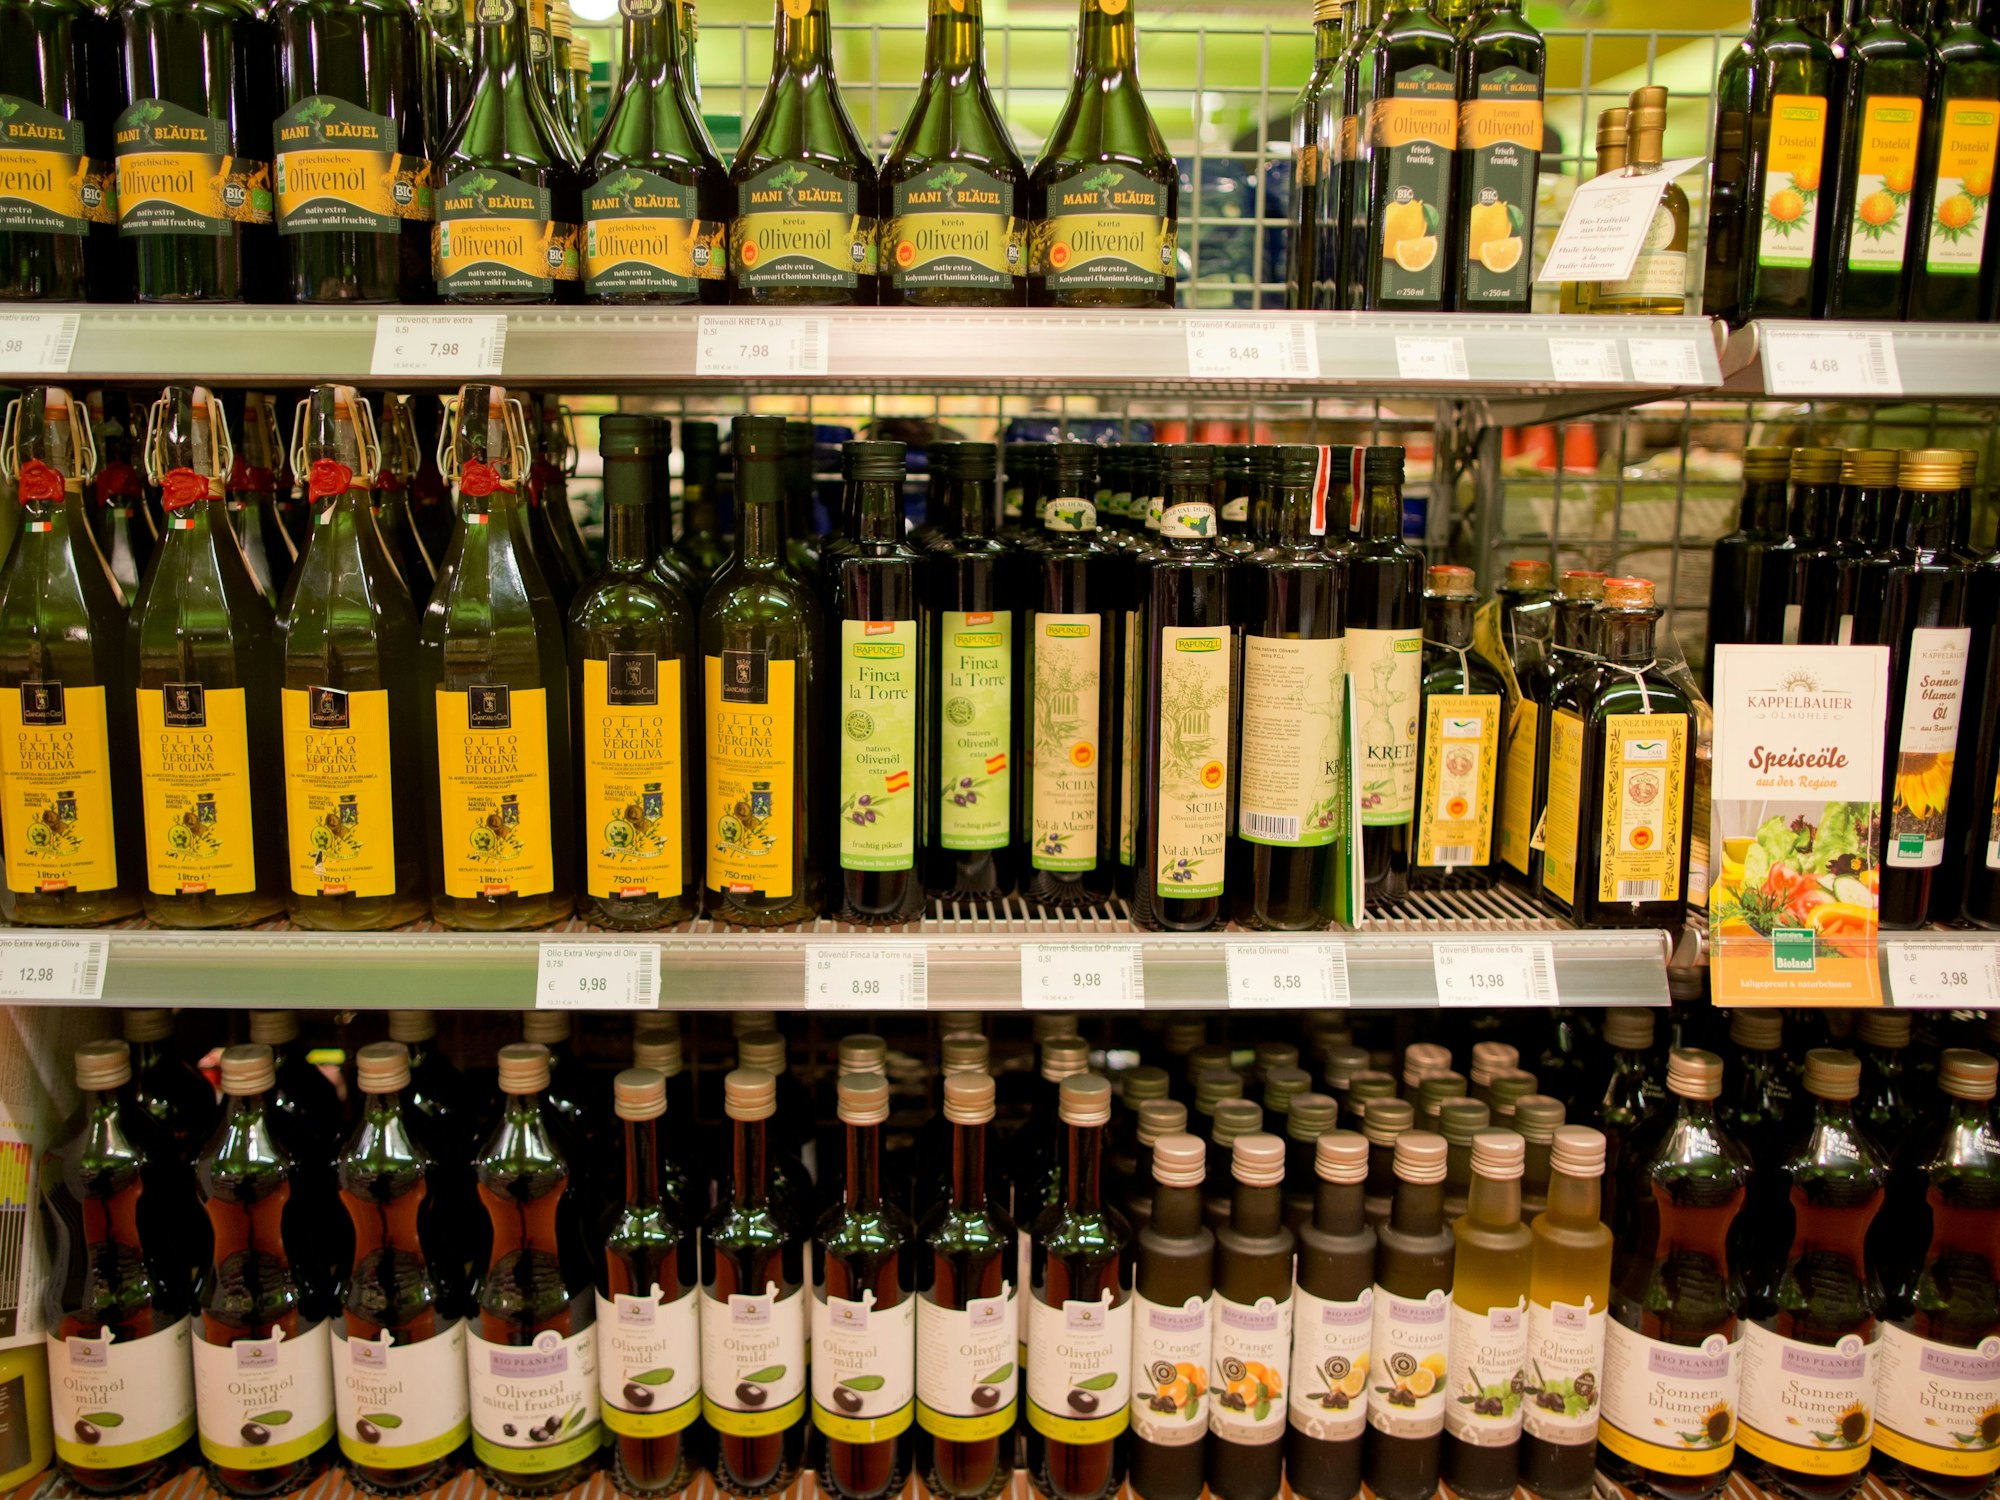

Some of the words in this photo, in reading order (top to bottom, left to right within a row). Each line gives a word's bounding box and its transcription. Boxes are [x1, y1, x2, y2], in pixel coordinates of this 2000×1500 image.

[117, 130, 140, 143] MANI
[155, 126, 207, 141] BLÄUEL
[282, 125, 309, 141] MANI
[326, 121, 378, 139] BLÄUEL
[1778, 136, 1816, 147] Distelöl
[1871, 138, 1910, 150] Distelöl
[1951, 141, 1989, 153] Distelöl
[1411, 146, 1431, 155] frisch
[1496, 146, 1515, 155] frisch
[124, 170, 194, 194] Olivenöl
[290, 168, 365, 191] Olivenöl
[154, 219, 172, 227] mild
[174, 219, 205, 229] fruchtig
[453, 235, 523, 256] Olivenöl
[599, 235, 668, 256] Olivenöl
[759, 229, 831, 250] Olivenöl
[916, 230, 989, 251] Olivenöl
[1072, 230, 1144, 252] Olivenöl
[630, 279, 645, 287] mild
[647, 279, 677, 287] fruchtig
[704, 318, 735, 326] Olivenöl
[738, 318, 766, 326] KRETA
[429, 343, 459, 357] 7,98
[740, 345, 769, 357] 7,98
[1230, 347, 1259, 359] 8,48
[1810, 359, 1839, 372] 4,68
[960, 656, 998, 669] Finca
[859, 667, 900, 682] Finca
[951, 673, 962, 686] la
[967, 673, 1005, 686] Torre
[850, 685, 860, 698] la
[866, 685, 908, 698] Torre
[1922, 689, 1956, 700] blumen
[1748, 697, 1852, 709] KAPPELBAUER
[1772, 711, 1828, 720] ÖLMÜHLE
[1933, 703, 1947, 720] Öl
[1612, 719, 1639, 727] NUÑEZ
[1653, 719, 1682, 727] PRADO
[603, 739, 662, 748] VERGINE
[718, 734, 772, 747] VERGINE
[20, 751, 74, 760] VERGINE
[162, 753, 214, 762] VERGINE
[306, 755, 357, 763] VERGINE
[465, 755, 518, 764] VERGINE
[1749, 746, 1849, 774] Speiseöle
[21, 761, 35, 770] DI
[38, 760, 74, 770] OLIVA
[163, 762, 177, 771] DI
[180, 762, 214, 771] OLIVA
[307, 764, 320, 773] DI
[323, 764, 356, 773] OLIVA
[465, 764, 480, 773] DI
[484, 764, 518, 773] OLIVA
[1756, 779, 1774, 787] aus
[1777, 776, 1795, 786] der
[1798, 776, 1838, 790] Region
[1072, 811, 1094, 820] DOP
[1036, 819, 1049, 829] Val
[1051, 819, 1059, 829] di
[1063, 820, 1094, 831] Mazara
[1202, 833, 1223, 844] DOP
[1163, 845, 1177, 855] Val
[1180, 845, 1188, 856] di
[1192, 845, 1222, 856] Mazara
[724, 870, 739, 879] 750
[585, 950, 612, 959] Vergine
[818, 951, 847, 959] Olivenöl
[851, 951, 868, 959] Finca
[880, 951, 899, 959] Torre
[1440, 945, 1469, 953] Olivenöl
[1777, 958, 1812, 969] Bioland
[20, 969, 53, 981] 12,98
[1073, 973, 1100, 987] 9,98
[1941, 972, 1967, 986] 3,98
[580, 978, 607, 993] 9,98
[1274, 976, 1301, 990] 8,58
[1469, 975, 1504, 988] 13,98
[1740, 979, 1788, 989] kaltgepresst
[1798, 980, 1852, 988] naturbelassen
[852, 981, 879, 995] 8,98
[724, 1337, 779, 1351] Olivenöl
[824, 1340, 877, 1358] Olivenöl
[623, 1352, 652, 1363] mild
[737, 1351, 766, 1362] mild
[1057, 1345, 1113, 1358] Olivenöl
[1539, 1347, 1595, 1364] Balsamico
[834, 1357, 863, 1369] mild
[1070, 1359, 1099, 1369] mild
[1927, 1354, 1950, 1364] BIO
[64, 1377, 124, 1392] Olivenöl
[228, 1376, 293, 1394] Olivenöl
[346, 1377, 403, 1393] Olivenöl
[75, 1393, 108, 1404] mild
[243, 1392, 278, 1406] mild
[357, 1394, 387, 1406] mild
